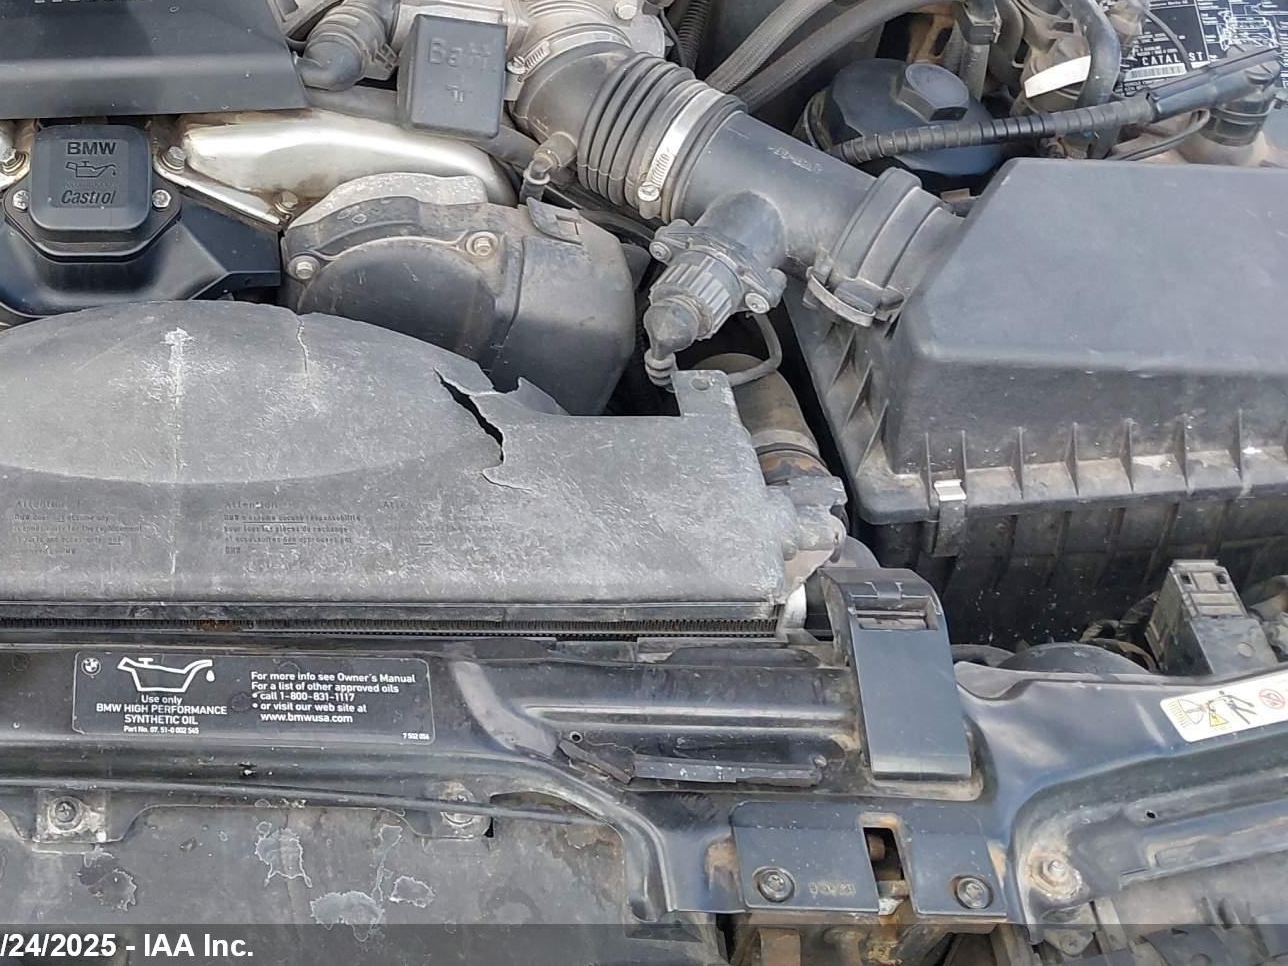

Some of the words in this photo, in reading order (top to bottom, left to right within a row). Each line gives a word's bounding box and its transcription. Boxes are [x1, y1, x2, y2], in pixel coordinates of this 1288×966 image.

[1142, 51, 1204, 66] CATALST
[67, 141, 116, 155] BMW
[61, 190, 116, 204] Castrol
[251, 671, 268, 680] For
[270, 673, 296, 681] more
[298, 672, 316, 681] info
[318, 674, 335, 682] see
[380, 674, 416, 683] Manual
[251, 682, 268, 690] For
[278, 682, 294, 690] list
[295, 682, 306, 691] of
[307, 682, 333, 692] other
[334, 684, 380, 694] approved
[381, 684, 400, 693] oils
[141, 694, 160, 703] Use
[162, 694, 182, 705] only
[260, 692, 277, 700] call
[280, 692, 355, 702] 1-800-831-1117
[96, 703, 122, 712] BMW
[124, 704, 149, 713] HIGH
[151, 704, 228, 715] PERFORMANCE
[273, 702, 294, 711] visit
[296, 704, 312, 712] our
[314, 703, 335, 712] web
[337, 703, 355, 712] site
[357, 704, 368, 713] at
[124, 714, 180, 724] SYNTHETIC
[182, 716, 199, 725] OIL
[260, 712, 354, 723] www.bmwusa.com
